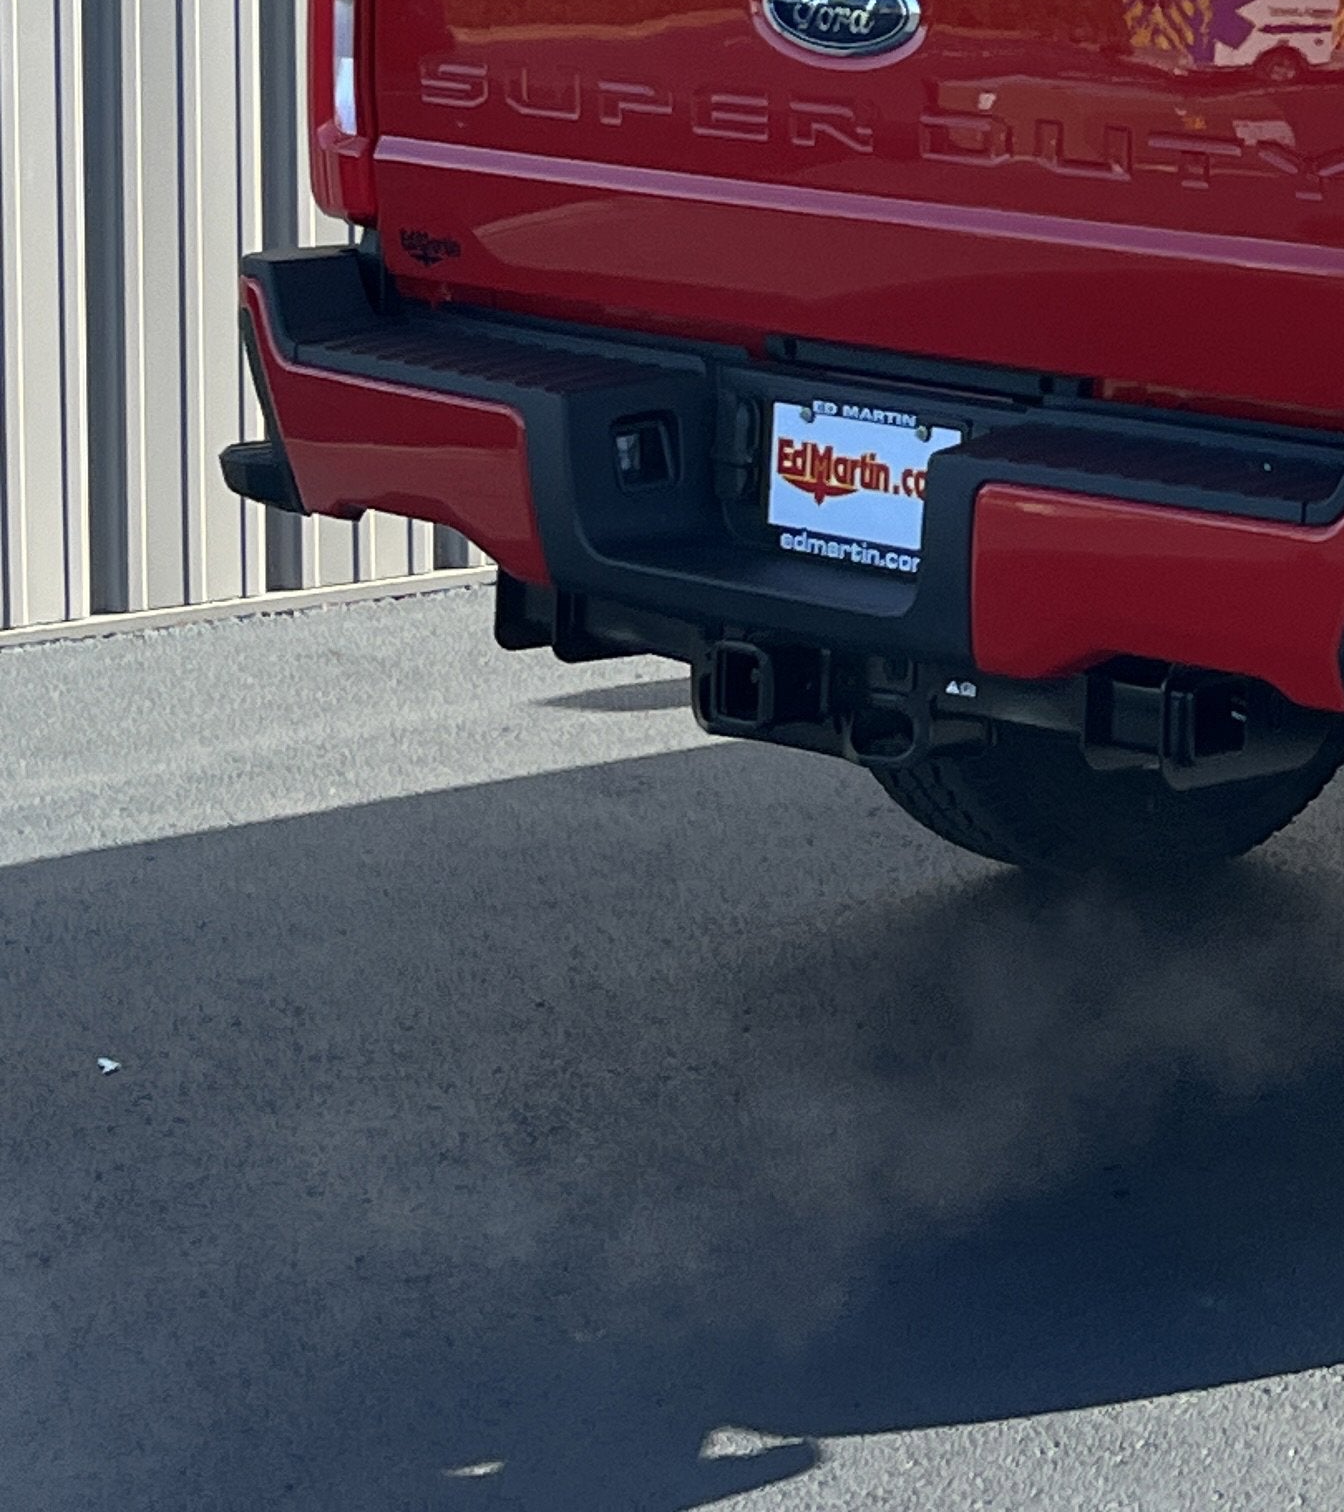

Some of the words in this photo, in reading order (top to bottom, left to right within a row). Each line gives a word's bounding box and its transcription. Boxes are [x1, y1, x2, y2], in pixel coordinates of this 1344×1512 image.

[419, 61, 875, 153] SUPER
[812, 400, 838, 416] ED
[842, 405, 918, 427] MARTIN
[777, 436, 928, 501] EdMartin.co
